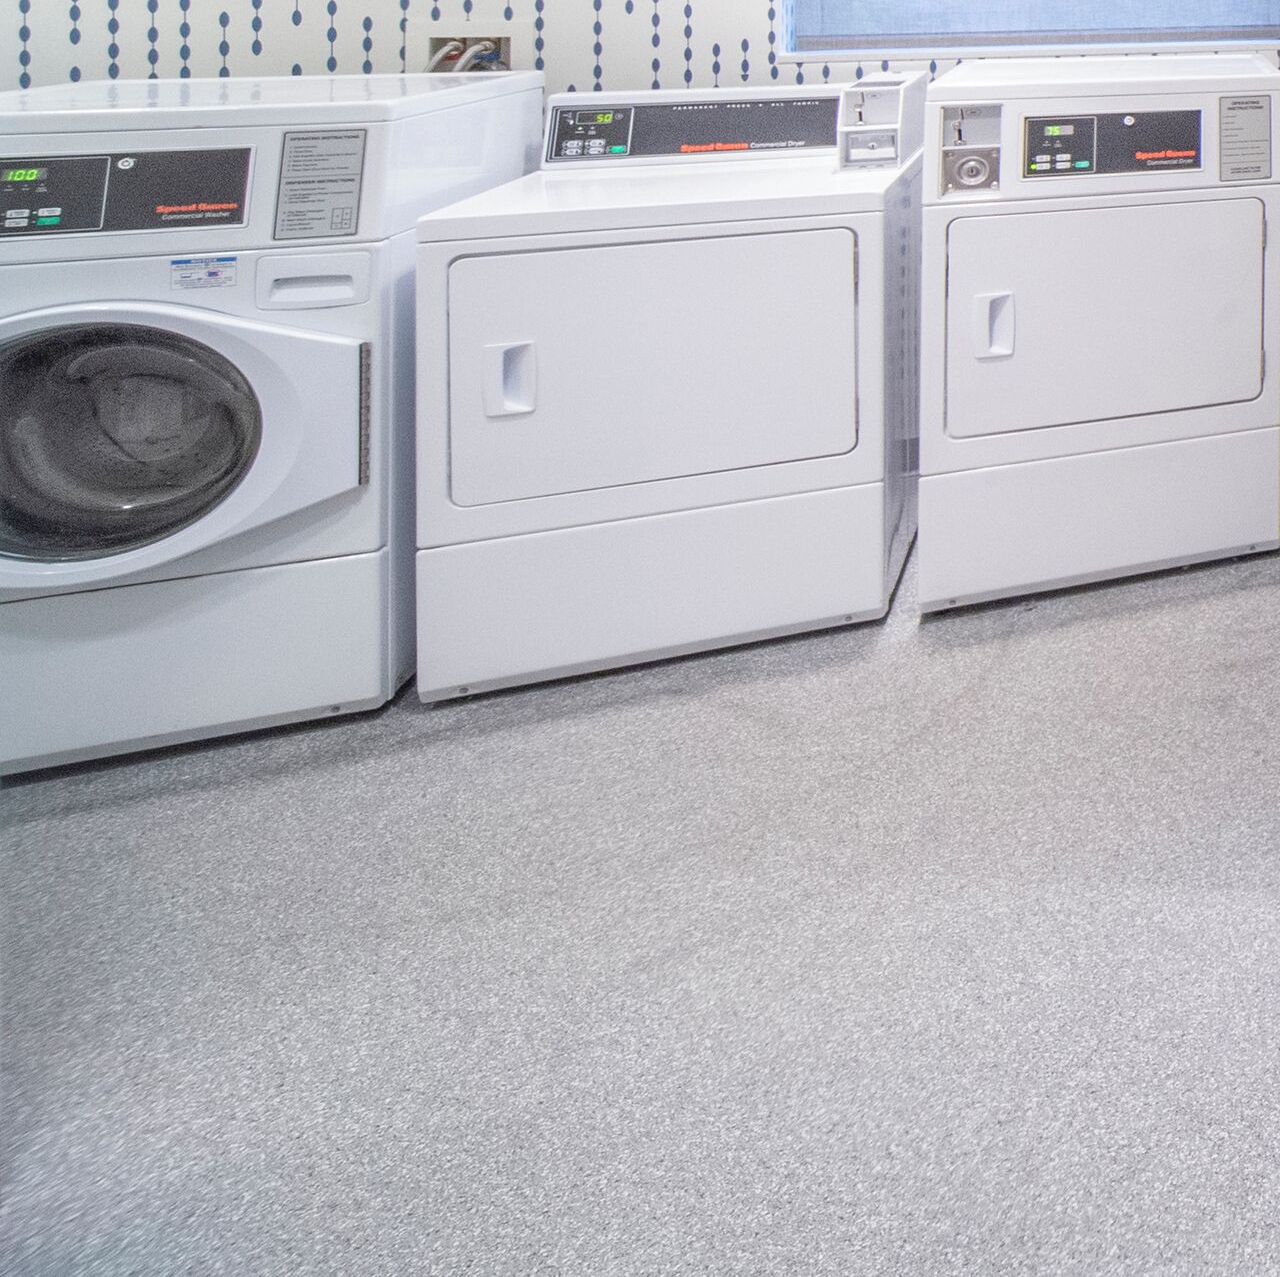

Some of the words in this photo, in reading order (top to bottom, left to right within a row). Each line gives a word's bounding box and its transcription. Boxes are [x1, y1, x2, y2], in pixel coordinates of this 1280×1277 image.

[596, 113, 613, 123] 50
[680, 143, 715, 153] Speed
[715, 142, 749, 151] Queen
[750, 141, 787, 149] Commercial
[788, 140, 806, 149] Dryer
[1135, 150, 1166, 160] Speed
[1166, 150, 1196, 158] Queen
[8, 169, 38, 181] 100
[156, 203, 197, 213] Speed
[197, 203, 239, 211] Queen
